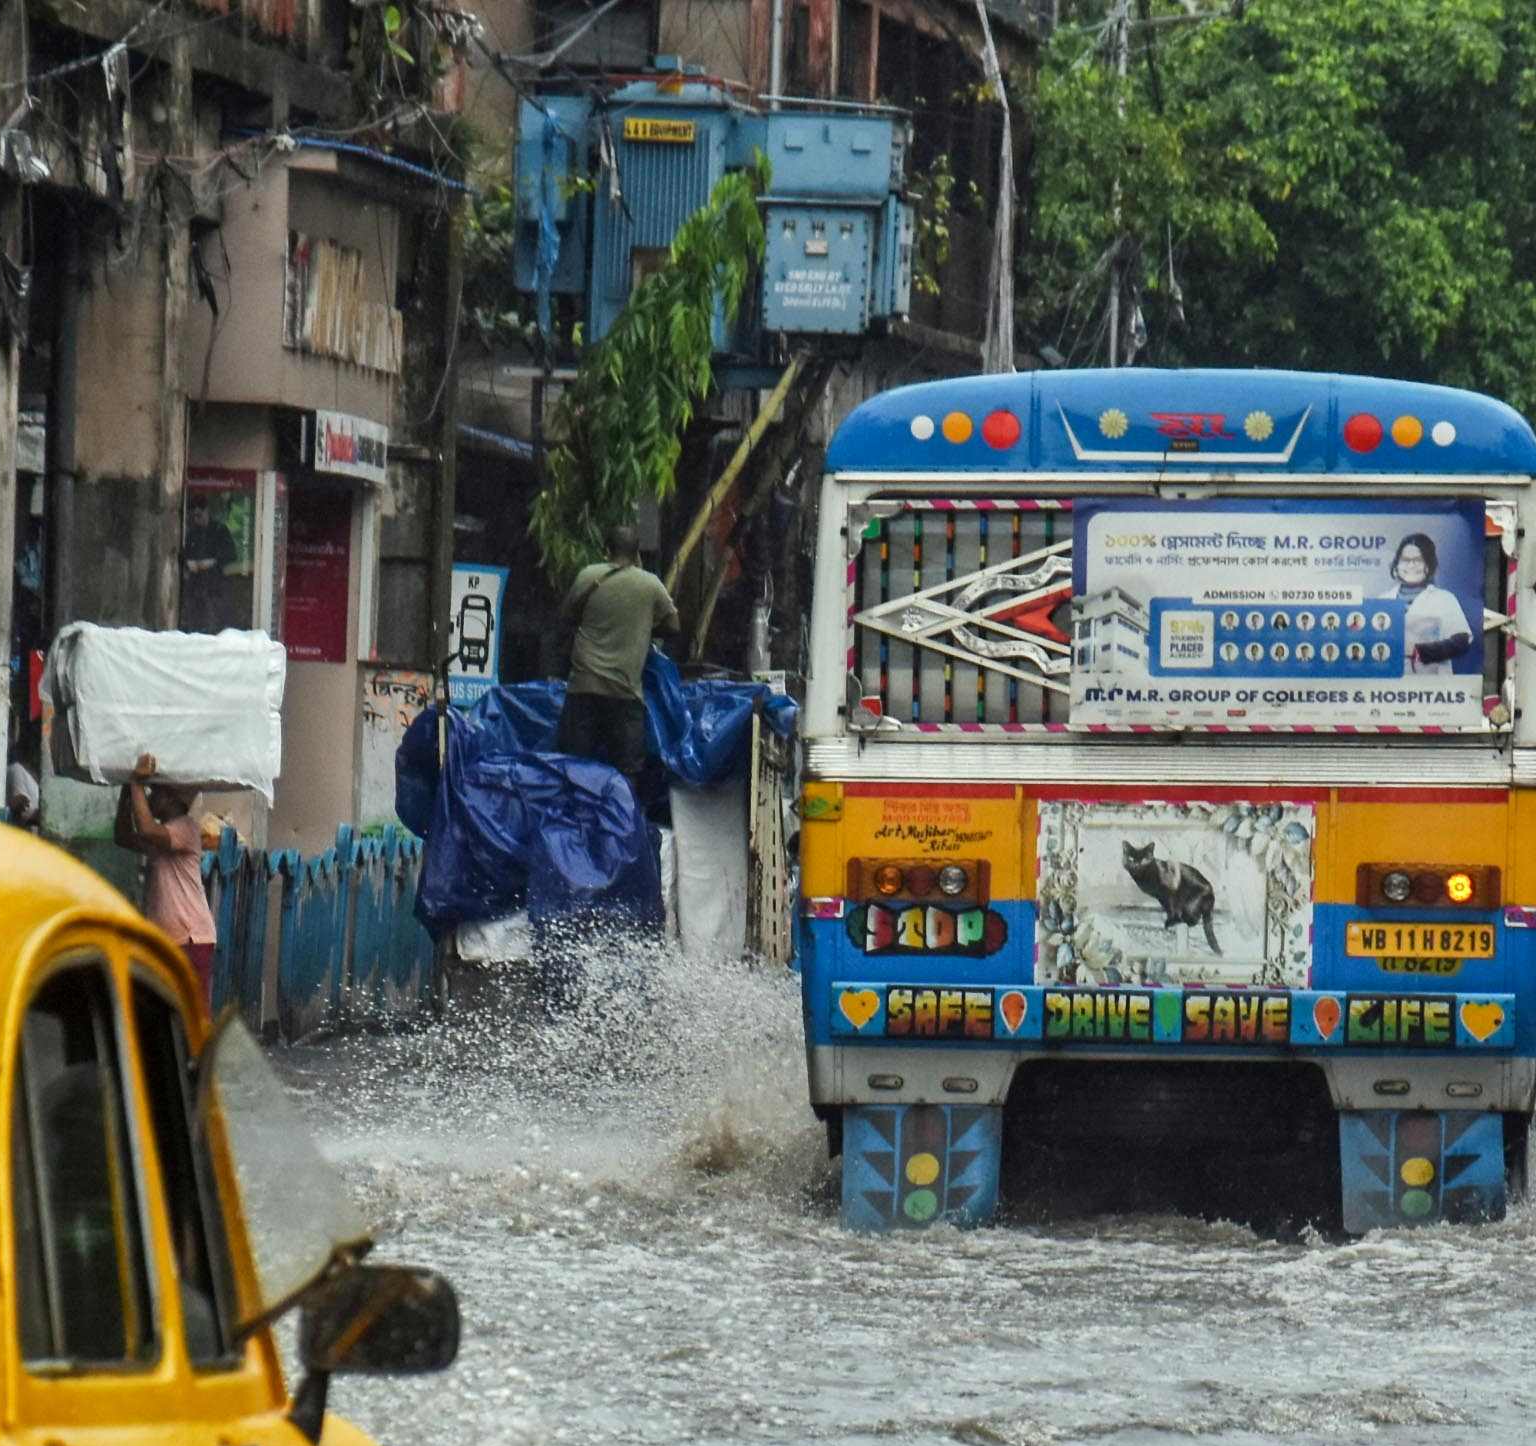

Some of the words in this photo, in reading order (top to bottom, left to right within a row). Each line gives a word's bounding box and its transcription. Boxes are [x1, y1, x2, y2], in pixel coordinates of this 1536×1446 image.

[1274, 535, 1314, 550] M.R.
[1319, 535, 1387, 550] GROUP
[468, 576, 480, 588] KP
[1203, 590, 1266, 600] ADMISSION
[1170, 643, 1204, 652] PLACED
[1126, 690, 1163, 703] M.R.
[1169, 690, 1231, 703] GROUP
[1236, 690, 1260, 703] OF
[1263, 690, 1348, 703] COLLEGES
[1353, 691, 1364, 703] &
[1370, 691, 1465, 704] HOSPITALS
[865, 903, 985, 951] STOP
[1362, 929, 1386, 950] WB
[1396, 929, 1415, 950] 11
[1423, 929, 1434, 950] H
[1440, 930, 1491, 951] 8219
[888, 988, 993, 1036] SAFE
[1045, 991, 1151, 1039] DRIVE
[1185, 995, 1288, 1041] SAVE
[1348, 998, 1451, 1042] LIFE
